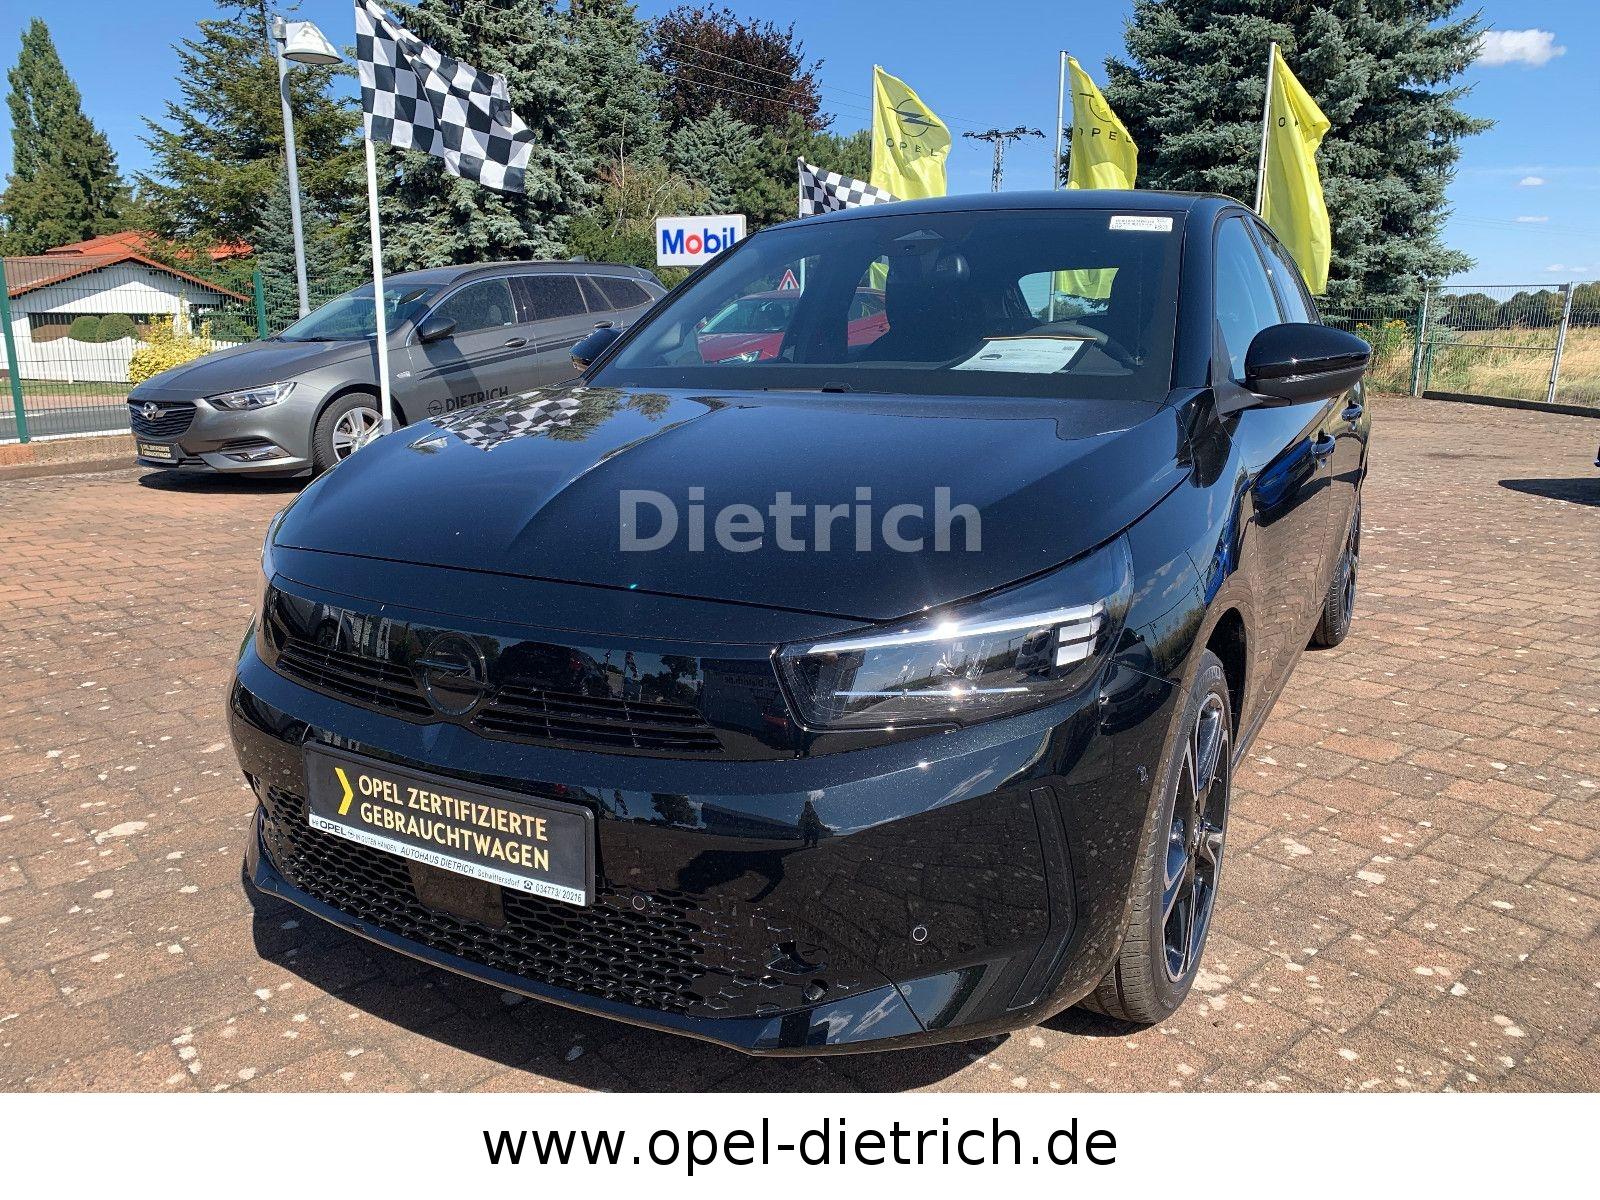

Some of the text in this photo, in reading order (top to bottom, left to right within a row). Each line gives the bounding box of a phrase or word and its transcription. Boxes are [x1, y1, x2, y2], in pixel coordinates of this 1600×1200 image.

[886, 138, 938, 157] OPEL
[662, 227, 735, 255] Mobil
[446, 386, 509, 412] DIETRICH
[358, 775, 548, 841] OPEL ZERTIFIZIERTE
[360, 802, 549, 871] GEBRAUCHTWAGEN
[320, 820, 347, 836] OPEL
[401, 846, 439, 865] AUTOHAUS
[440, 857, 475, 875] DIETRICH
[562, 889, 582, 903] 20216
